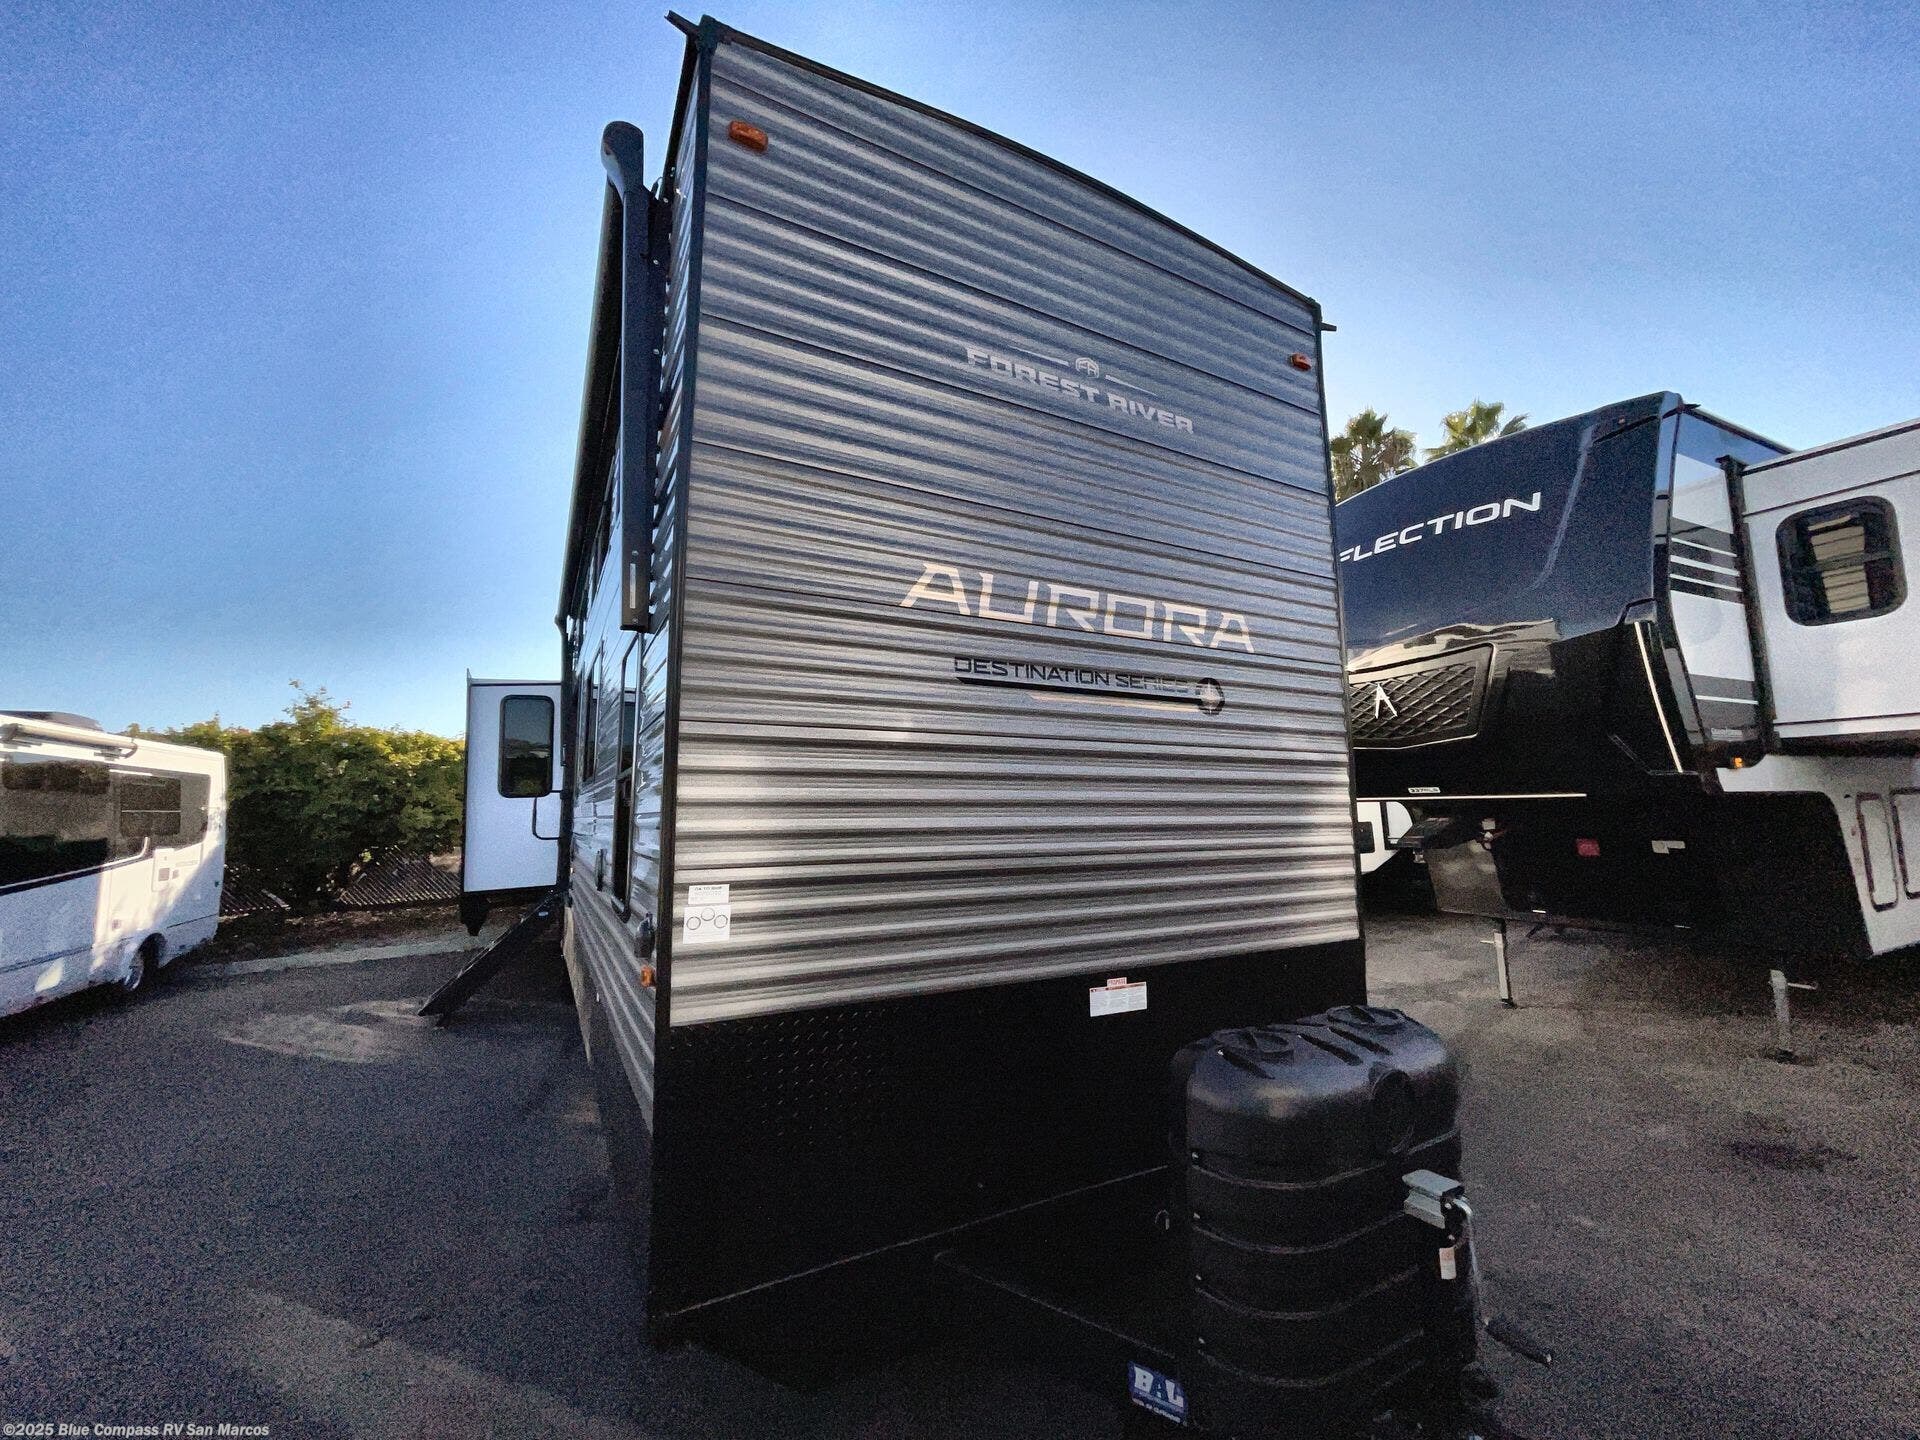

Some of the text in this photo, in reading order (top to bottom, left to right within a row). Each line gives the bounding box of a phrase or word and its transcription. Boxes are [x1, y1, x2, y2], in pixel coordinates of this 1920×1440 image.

[966, 346, 1194, 434] FOREST RIVER
[900, 563, 1255, 653] AURORA
[954, 656, 1110, 686] DESTINATION
